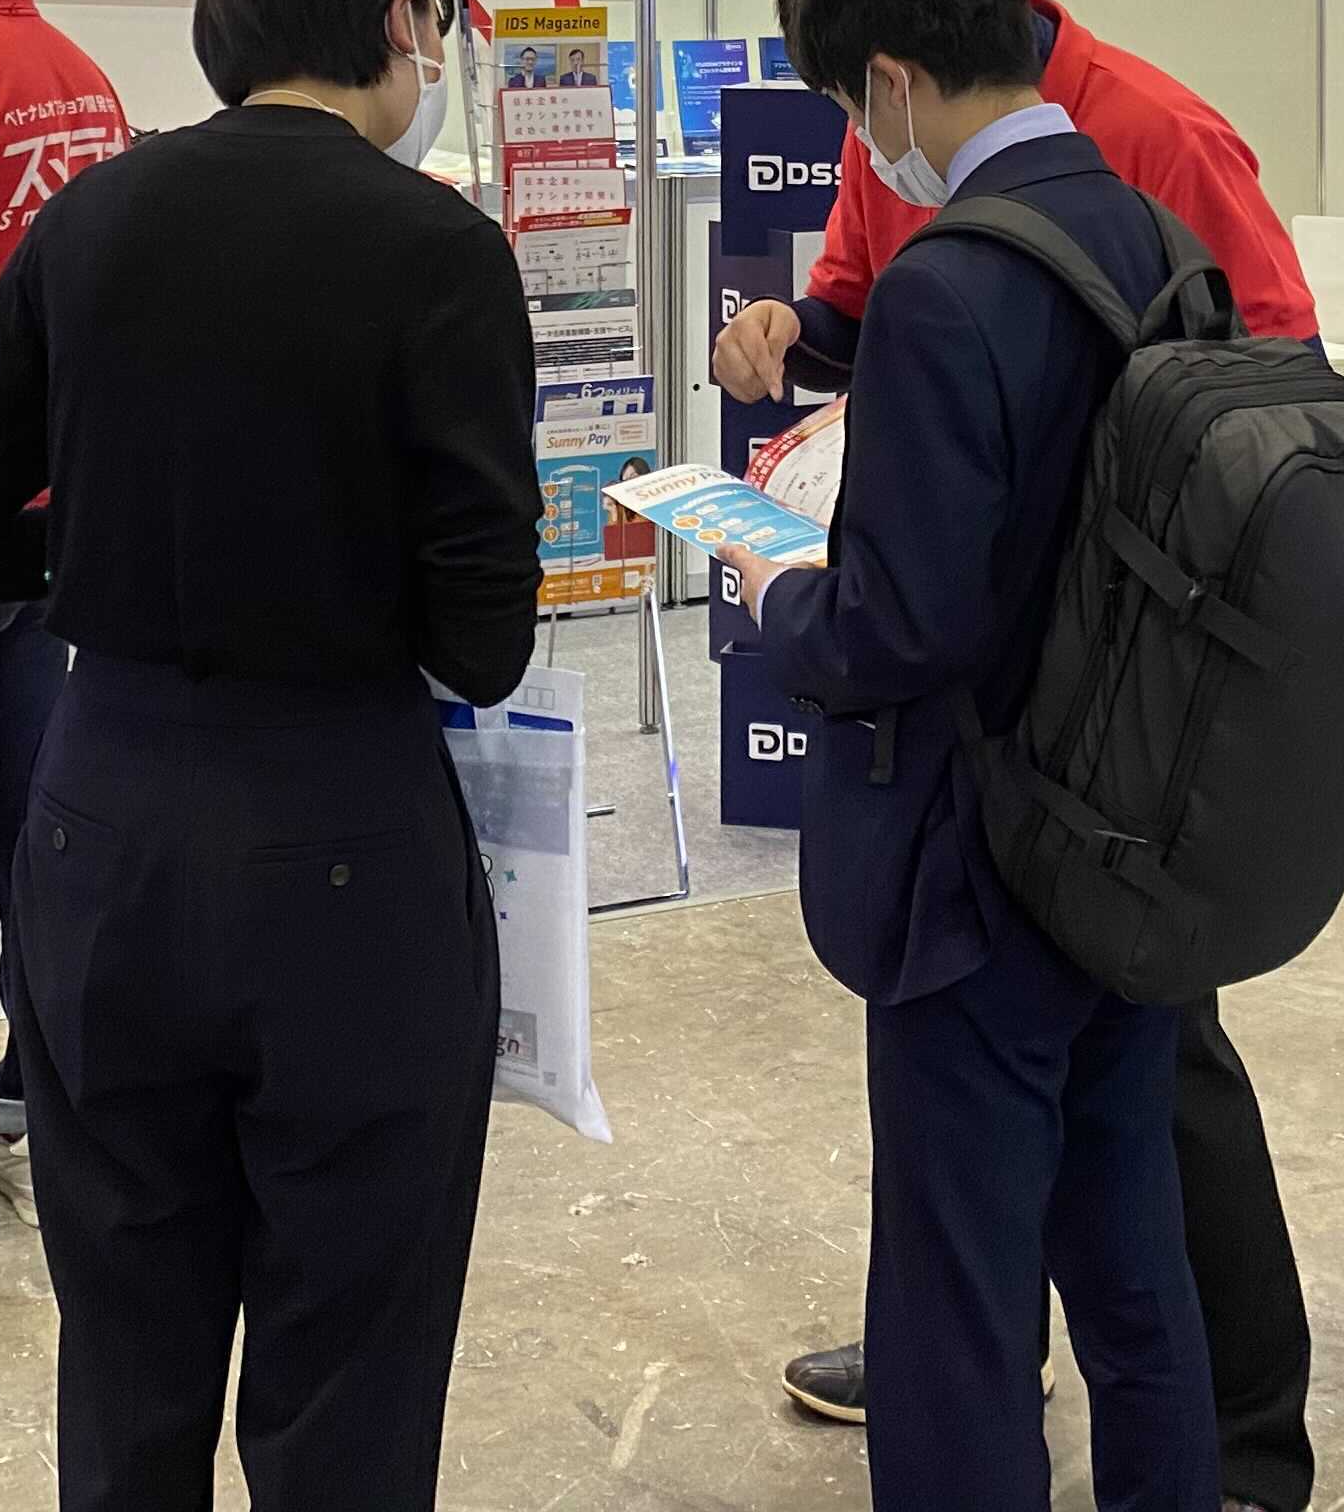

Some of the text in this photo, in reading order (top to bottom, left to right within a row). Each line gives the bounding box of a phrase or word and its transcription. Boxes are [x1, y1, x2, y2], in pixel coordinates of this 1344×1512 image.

[506, 15, 601, 33] IDS Magazine
[546, 432, 612, 449] Sunny Pay
